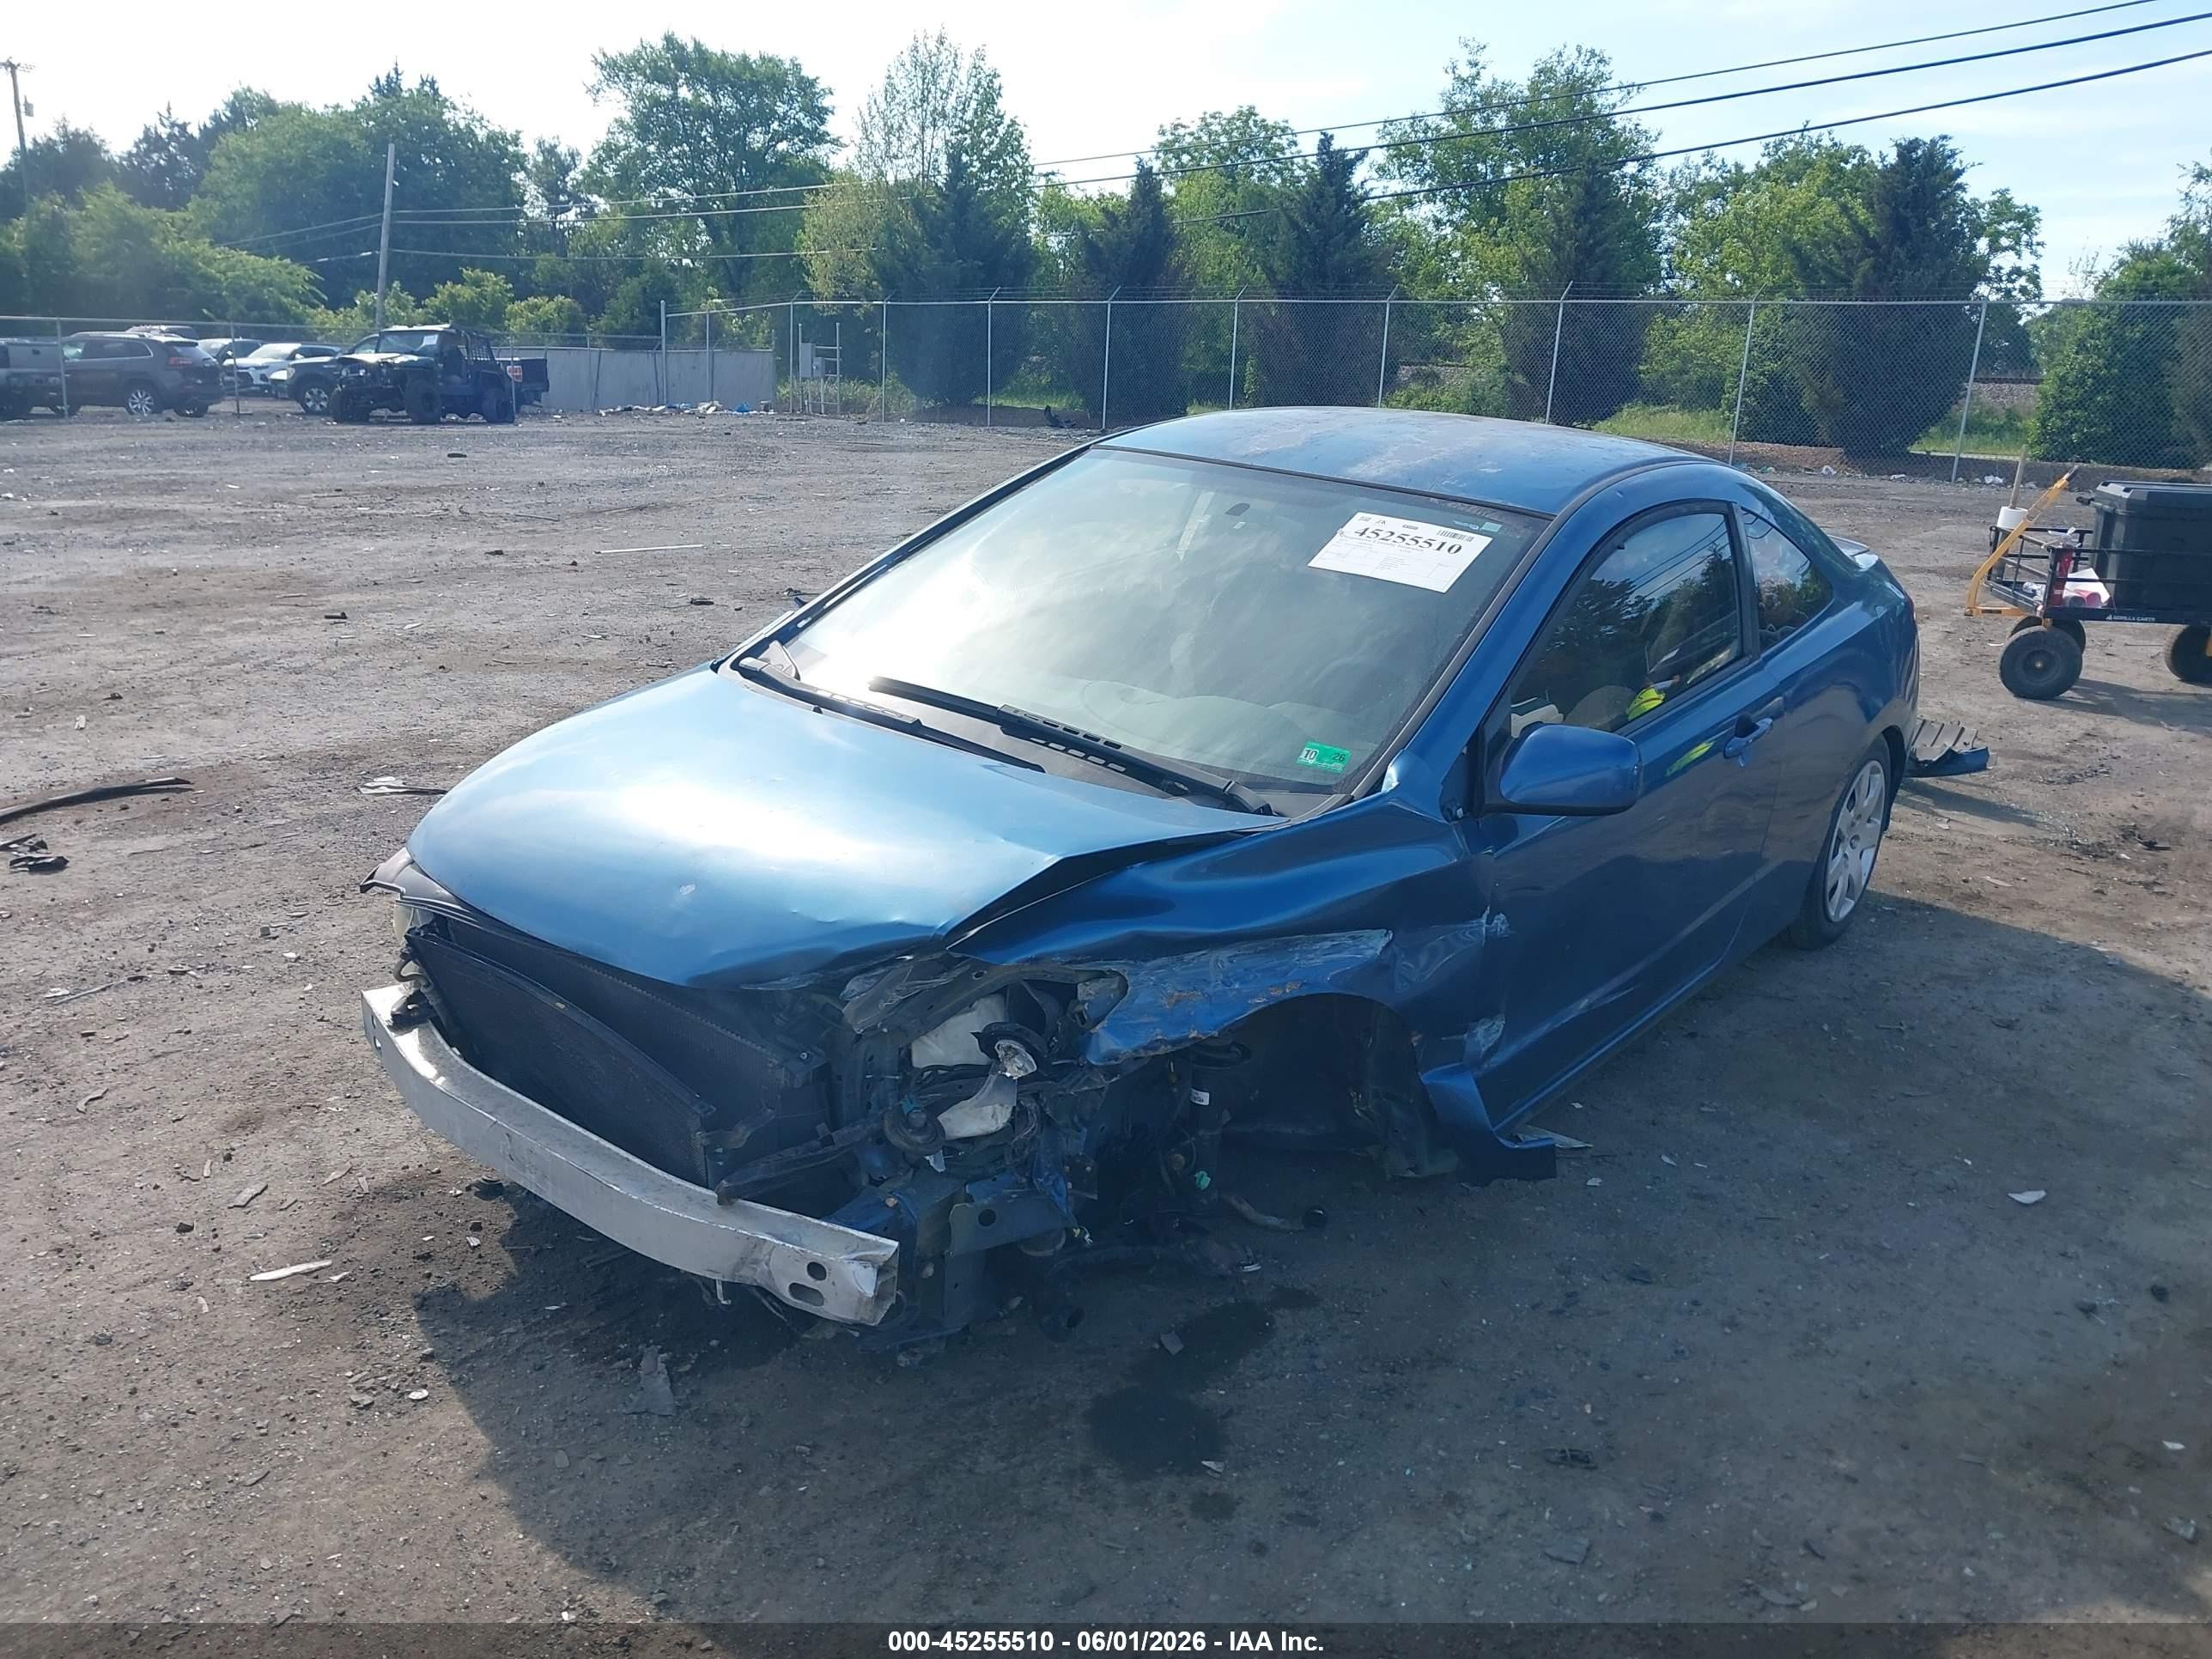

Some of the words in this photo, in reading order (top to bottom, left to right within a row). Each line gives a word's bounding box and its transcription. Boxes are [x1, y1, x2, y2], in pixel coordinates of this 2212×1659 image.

[1354, 526, 1462, 554] 45255510
[1304, 749, 1317, 760] 10
[1333, 753, 1346, 762] 26
